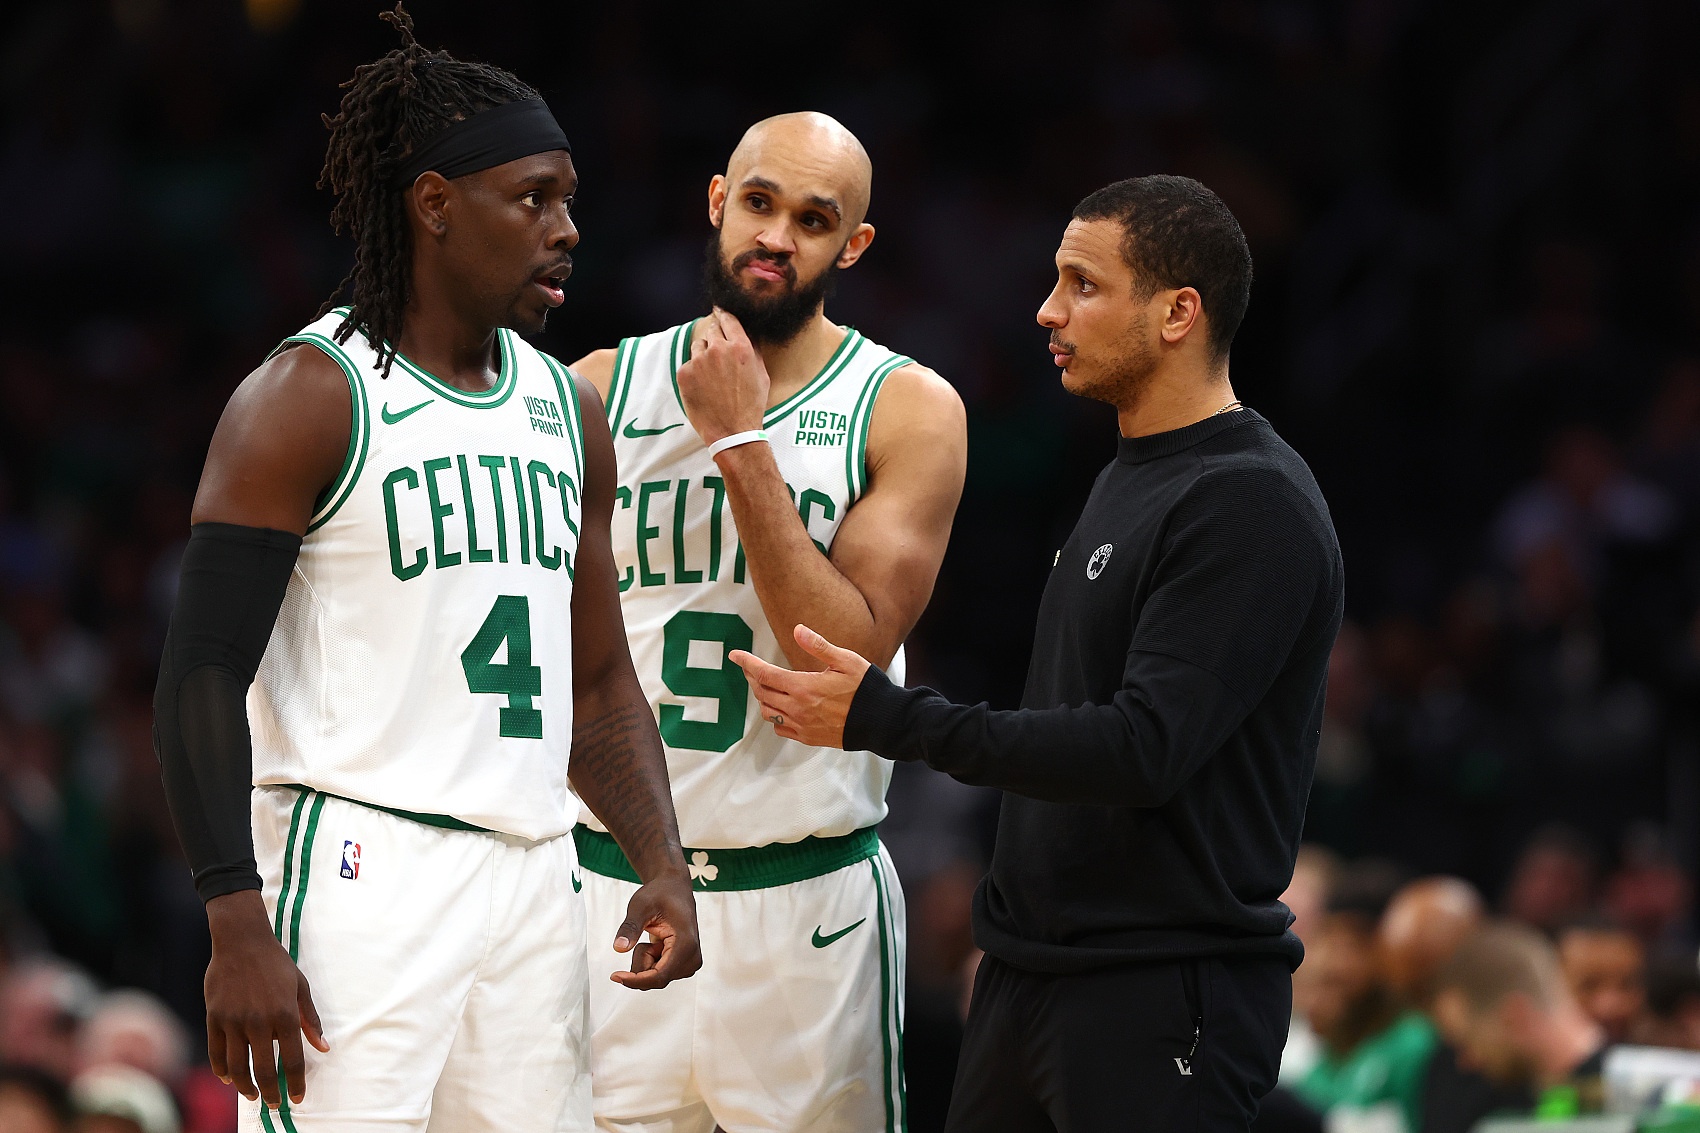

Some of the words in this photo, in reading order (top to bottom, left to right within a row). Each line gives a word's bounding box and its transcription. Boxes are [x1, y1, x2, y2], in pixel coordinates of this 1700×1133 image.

[523, 396, 561, 422] VISTA
[530, 417, 564, 438] PRINT
[794, 430, 846, 446] PRINT
[798, 410, 847, 431] VISTA
[382, 454, 581, 585] CELTICS
[610, 476, 836, 592] CELT
[460, 594, 543, 739] 4
[659, 610, 753, 753] 9
